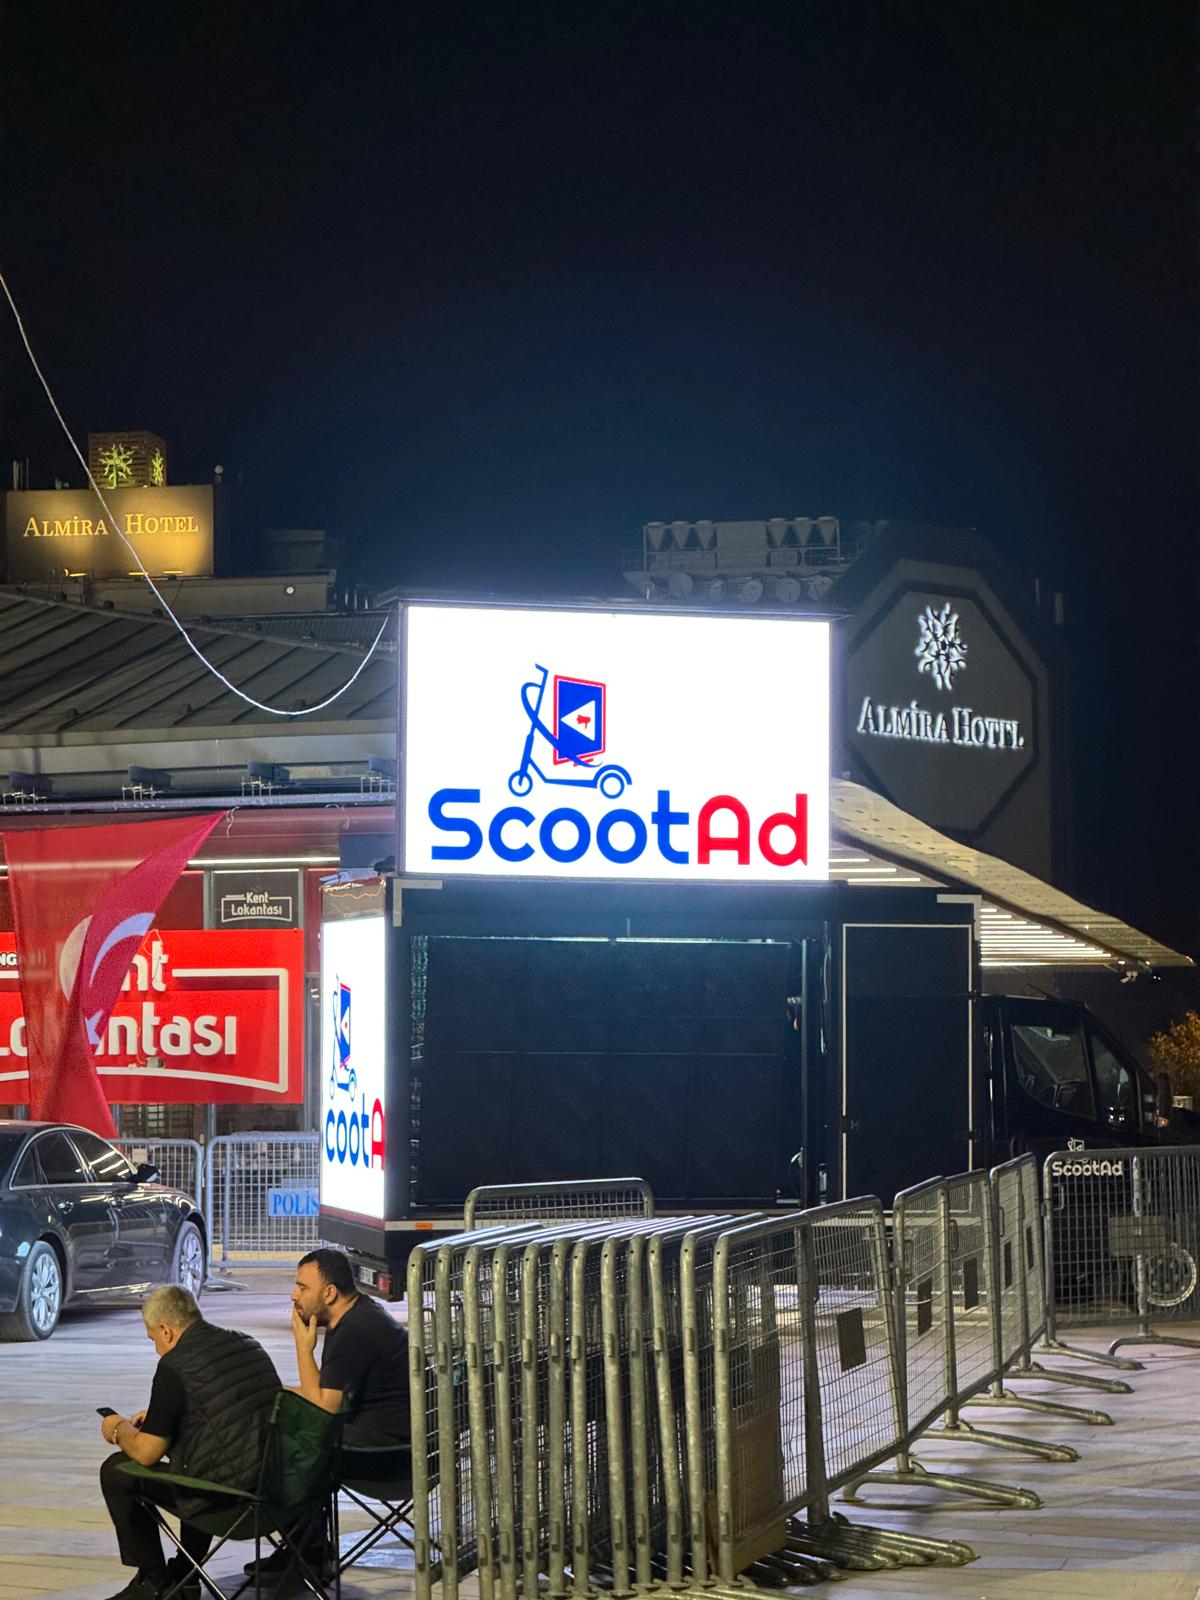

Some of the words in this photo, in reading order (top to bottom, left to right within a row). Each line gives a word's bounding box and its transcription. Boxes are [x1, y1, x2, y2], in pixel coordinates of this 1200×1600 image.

[125, 513, 199, 534] HOTEL
[428, 787, 808, 867] ScootAd
[246, 891, 269, 904] Kent
[231, 903, 282, 916] Lokantası
[121, 940, 169, 992] nt
[325, 1093, 385, 1171] cootA
[1051, 1160, 1123, 1177] ScootAd
